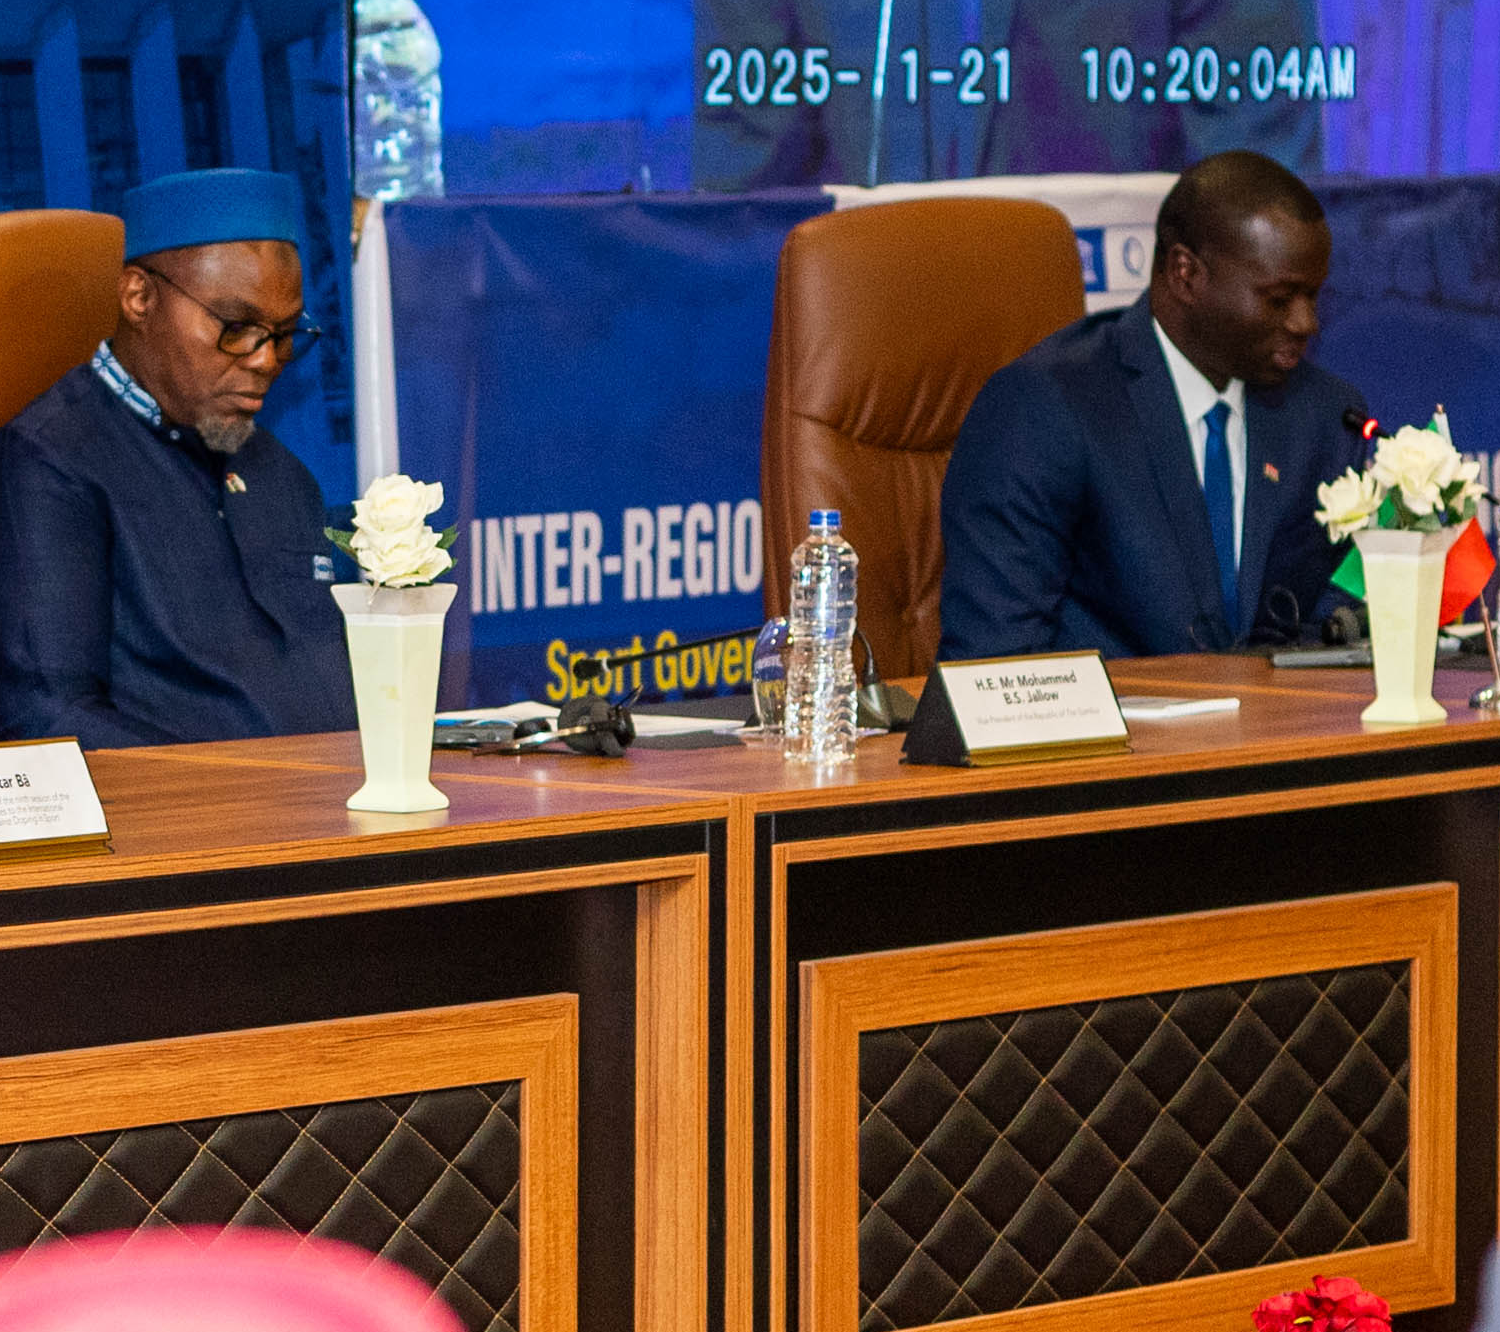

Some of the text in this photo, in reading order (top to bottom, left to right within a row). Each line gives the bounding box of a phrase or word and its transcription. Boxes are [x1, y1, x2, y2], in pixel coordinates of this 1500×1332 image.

[1081, 46, 1356, 103] 10:20:04AM
[470, 498, 763, 614] INTER-REGIO
[975, 669, 1077, 691] H.E. Mr Mohammed
[1028, 690, 1059, 704] Jallow
